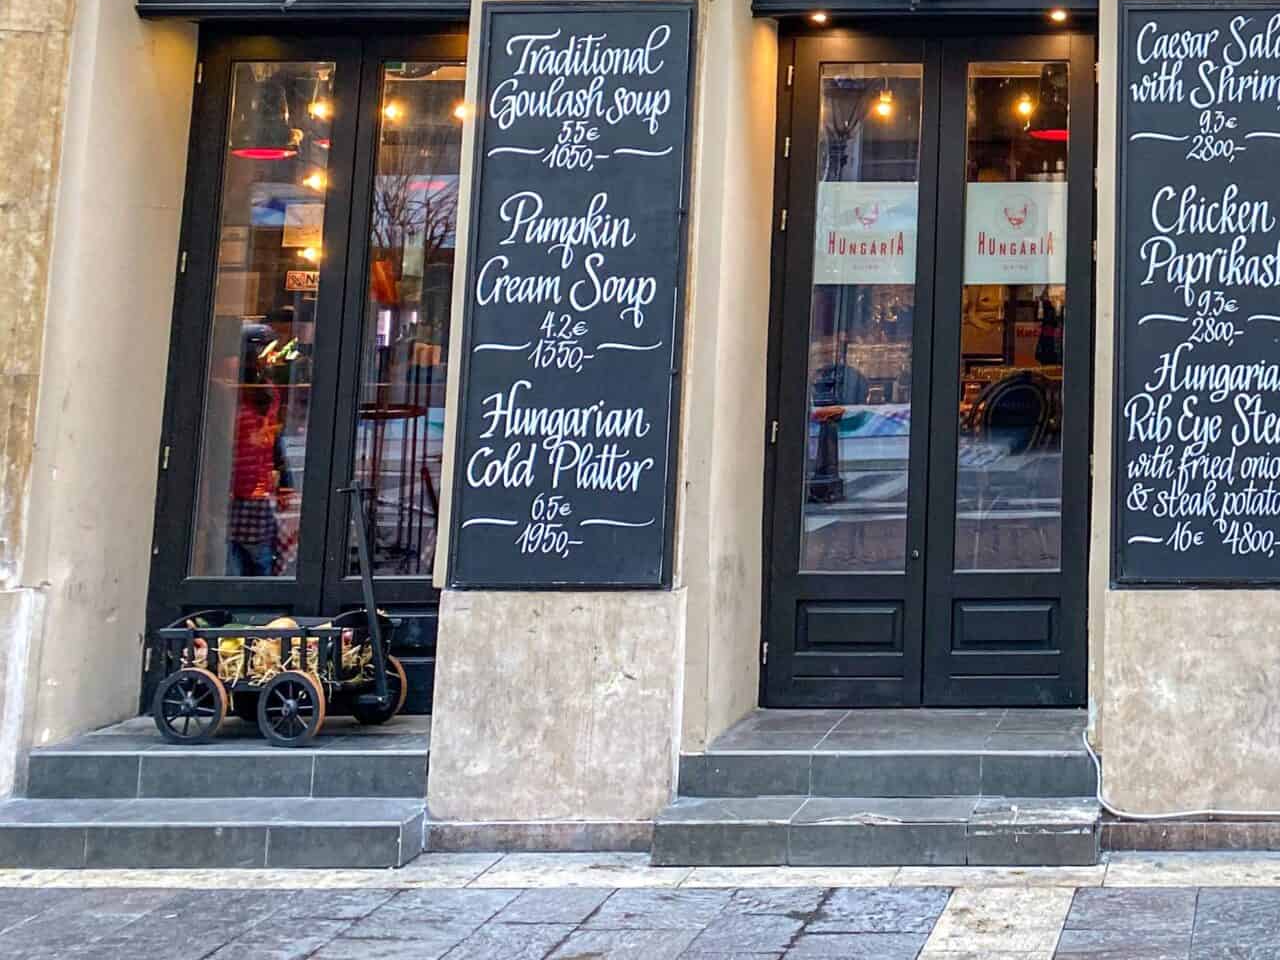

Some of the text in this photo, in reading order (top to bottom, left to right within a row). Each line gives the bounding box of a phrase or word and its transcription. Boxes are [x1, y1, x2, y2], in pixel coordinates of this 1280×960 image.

[506, 25, 670, 77] Traditional
[1136, 21, 1220, 65] Caesar
[1130, 60, 1185, 103] with
[489, 76, 671, 135] Goulash soup
[1199, 110, 1238, 135] 9.3€
[557, 120, 601, 145] 5.5€
[499, 191, 637, 269] Pumpkin
[1151, 183, 1276, 235] Chicken
[827, 231, 905, 257] HUNGARIA
[977, 231, 1055, 257] HUNGARIA
[475, 253, 657, 328] Cream Soup
[1196, 290, 1239, 317] 9.3€
[539, 310, 588, 339] 4.2€
[479, 380, 651, 450] Hungarian
[1124, 392, 1173, 443] Rib
[1176, 394, 1223, 456] Eye
[466, 440, 655, 492] Cold Platter
[1127, 444, 1176, 480] with
[1176, 446, 1236, 496] fried
[531, 492, 573, 522] 6.5€
[1127, 482, 1155, 512] &
[1152, 479, 1218, 518] steak
[1165, 520, 1206, 552] 16€
